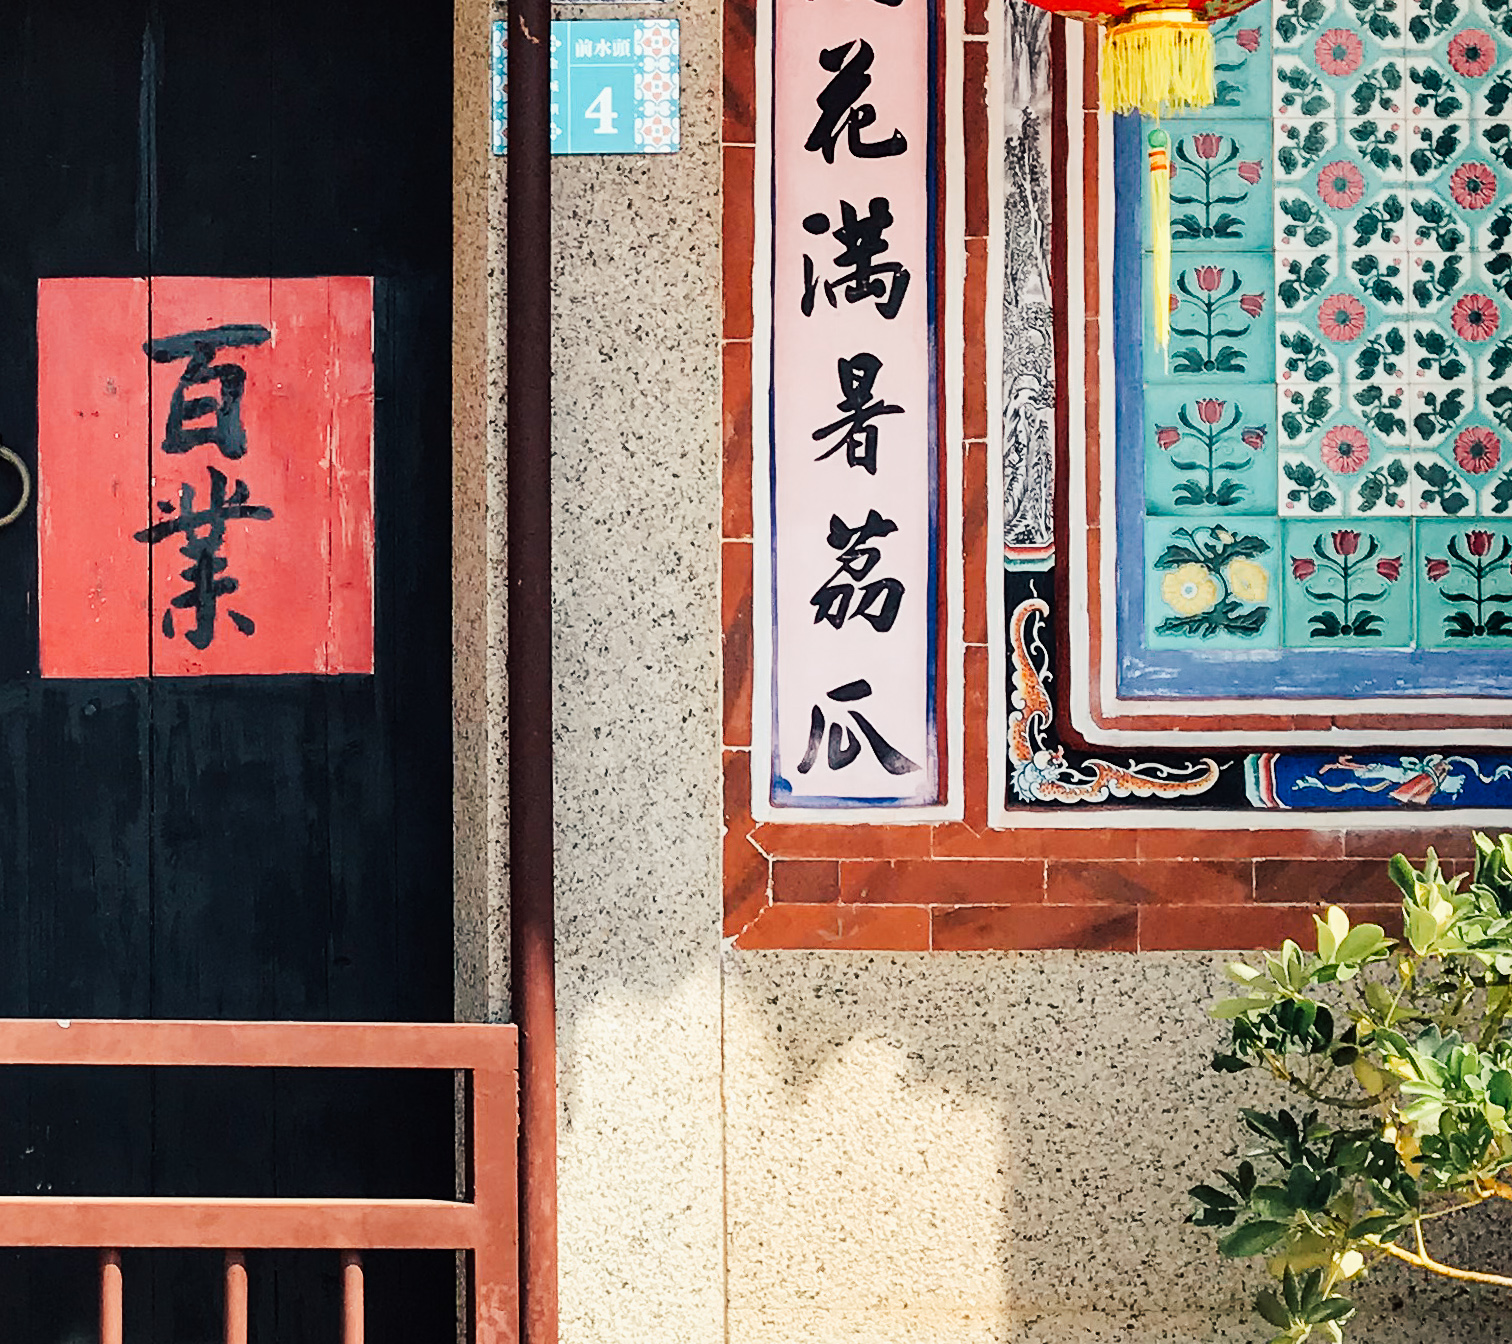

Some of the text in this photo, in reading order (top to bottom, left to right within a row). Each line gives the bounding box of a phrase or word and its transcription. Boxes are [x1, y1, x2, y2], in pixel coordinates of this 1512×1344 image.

[575, 38, 631, 58] 前水頭
[585, 87, 618, 134] 4
[134, 324, 274, 649] 百業
